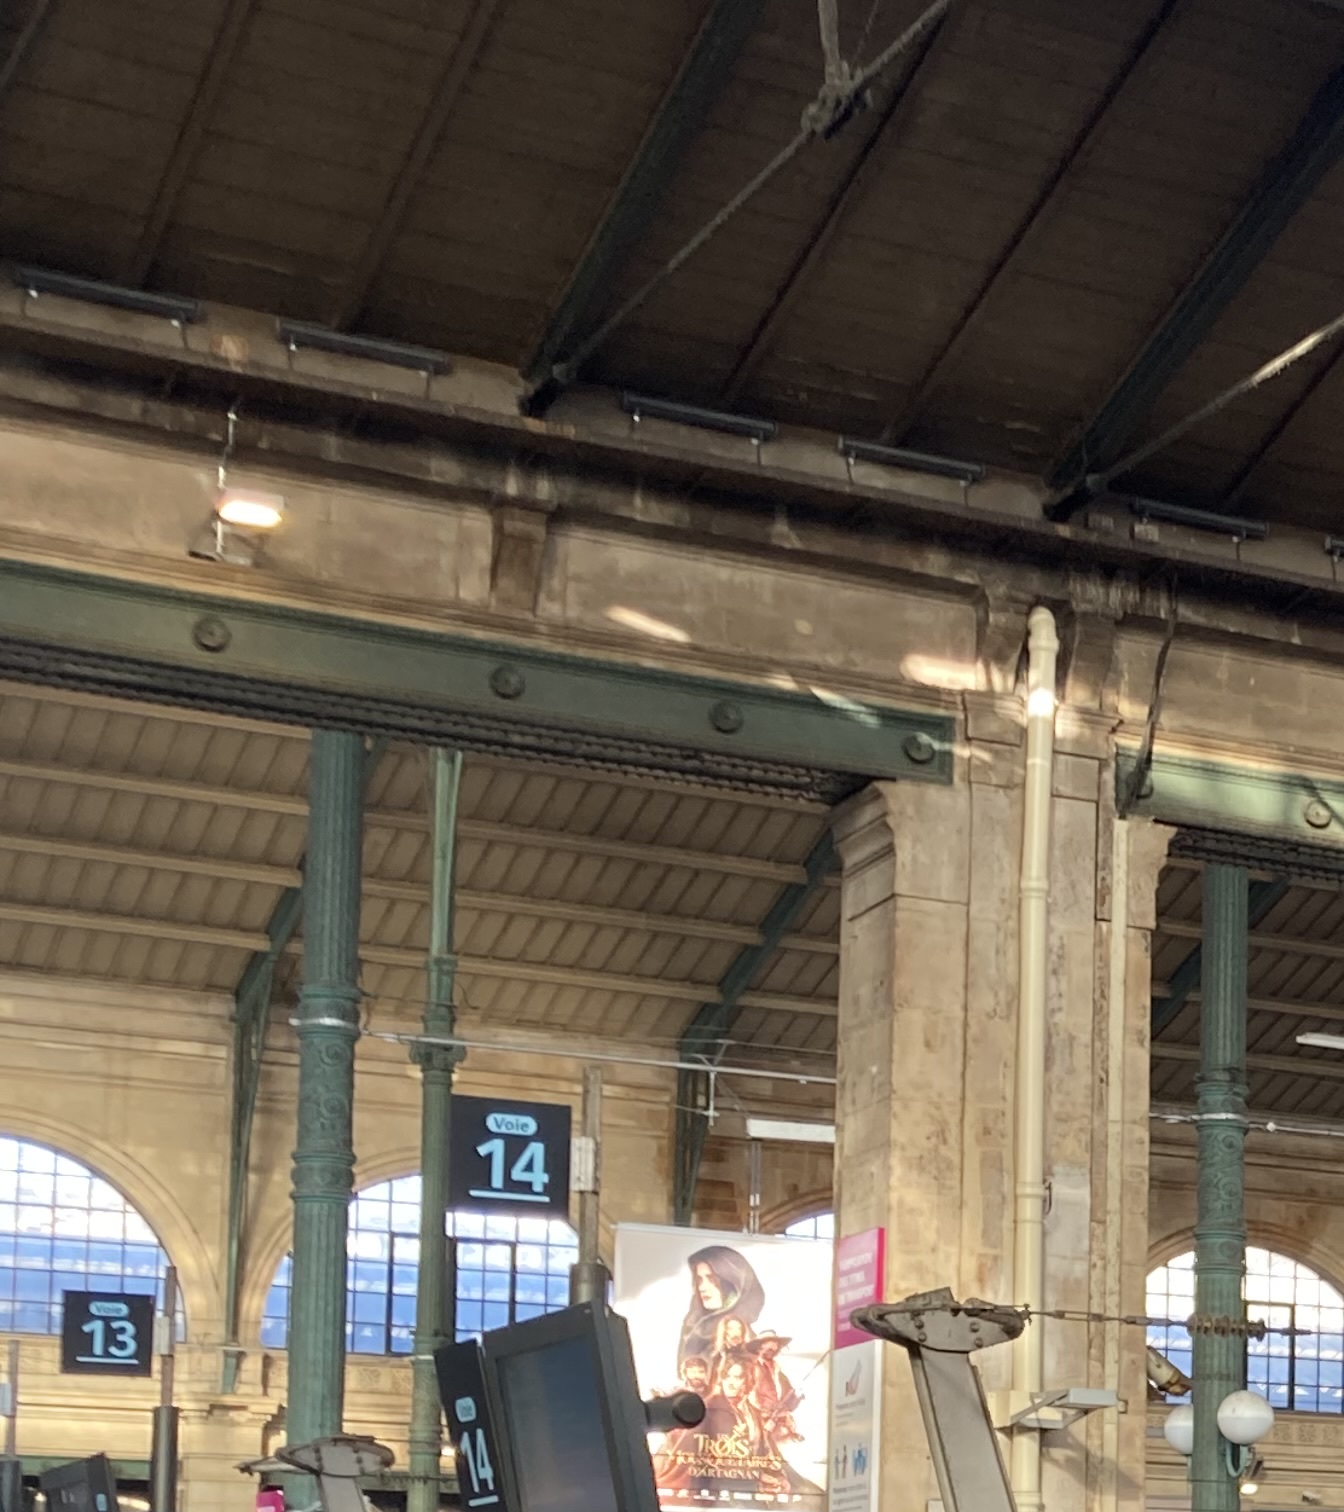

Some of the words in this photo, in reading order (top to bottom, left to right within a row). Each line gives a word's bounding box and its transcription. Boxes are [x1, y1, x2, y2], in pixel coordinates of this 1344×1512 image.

[492, 1116, 531, 1133] Voie
[475, 1138, 550, 1193] 14
[81, 1319, 138, 1358] 13
[459, 1427, 495, 1493] 14
